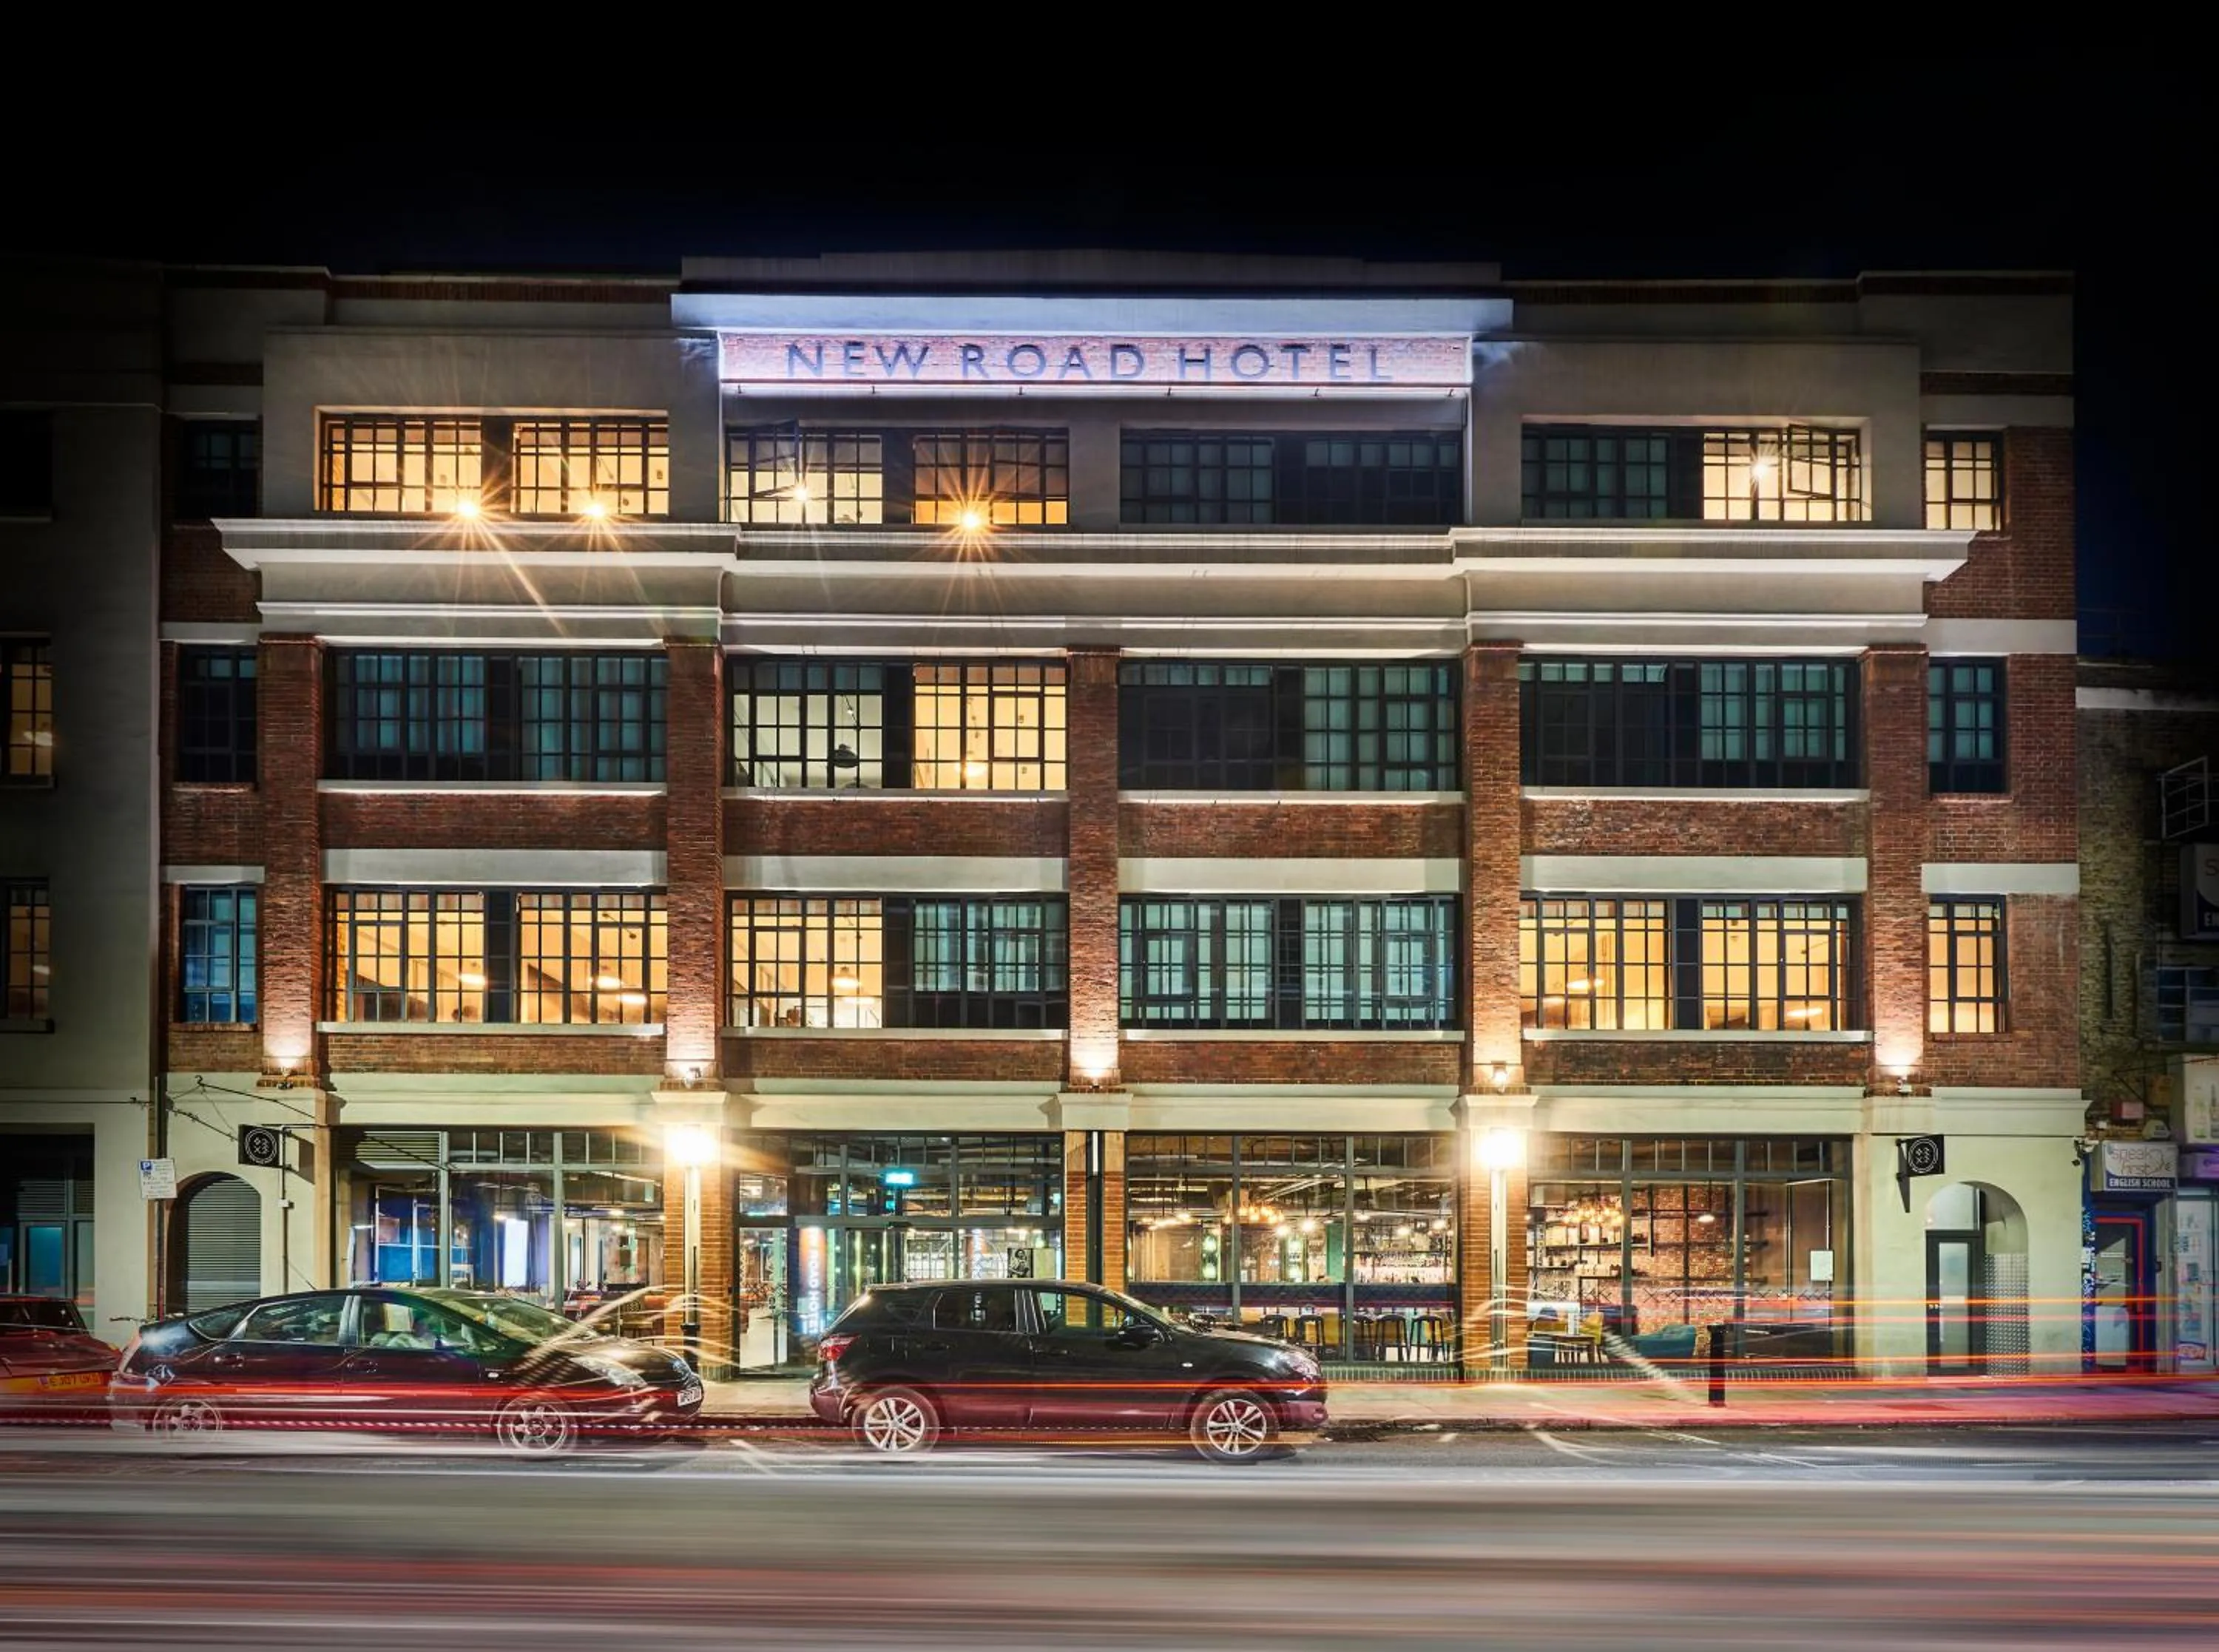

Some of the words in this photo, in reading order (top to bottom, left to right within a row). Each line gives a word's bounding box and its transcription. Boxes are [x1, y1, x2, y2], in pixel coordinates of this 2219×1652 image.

[787, 341, 929, 378] NEW
[959, 343, 1144, 379] ROAD
[1179, 343, 1392, 380] HOTEL
[2109, 1178, 2141, 1188] ENGLISH
[2141, 1179, 2171, 1188] SCHOOL
